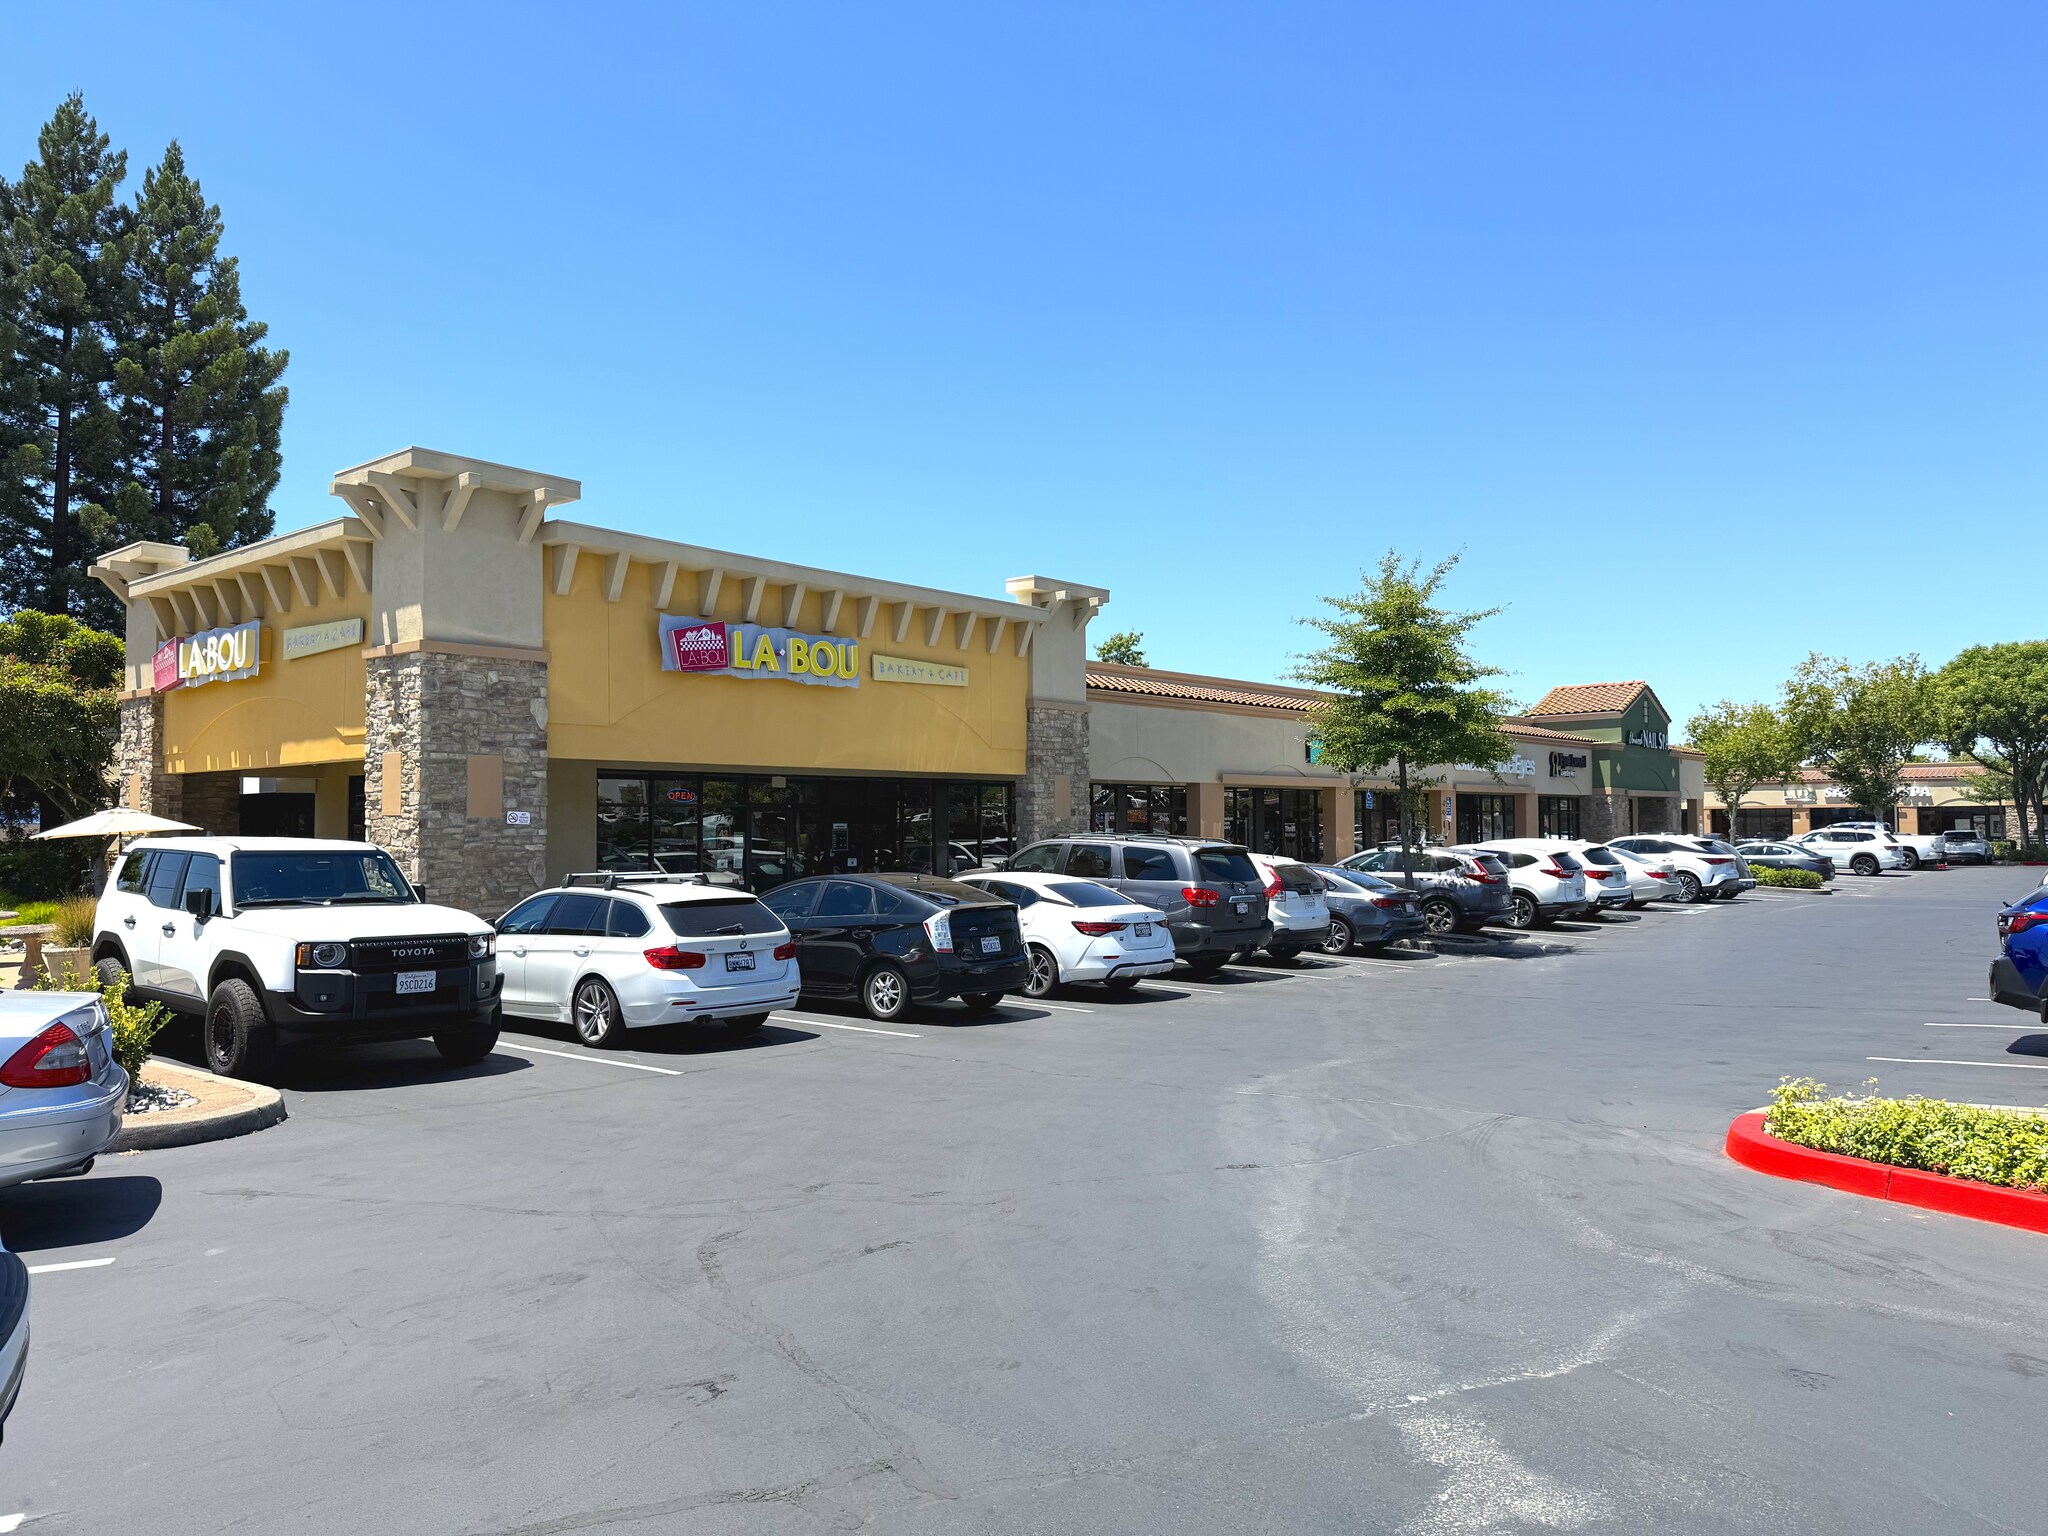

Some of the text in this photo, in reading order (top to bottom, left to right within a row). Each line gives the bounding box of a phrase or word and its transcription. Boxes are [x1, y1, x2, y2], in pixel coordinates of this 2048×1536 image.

[204, 629, 252, 674] BOU
[731, 631, 859, 680] LA BOU
[879, 661, 925, 677] BAKERY
[1643, 730, 1658, 749] NAIL
[668, 791, 694, 800] OPEN
[391, 947, 435, 958] TOYOTA
[399, 979, 434, 991] 9SCD216
